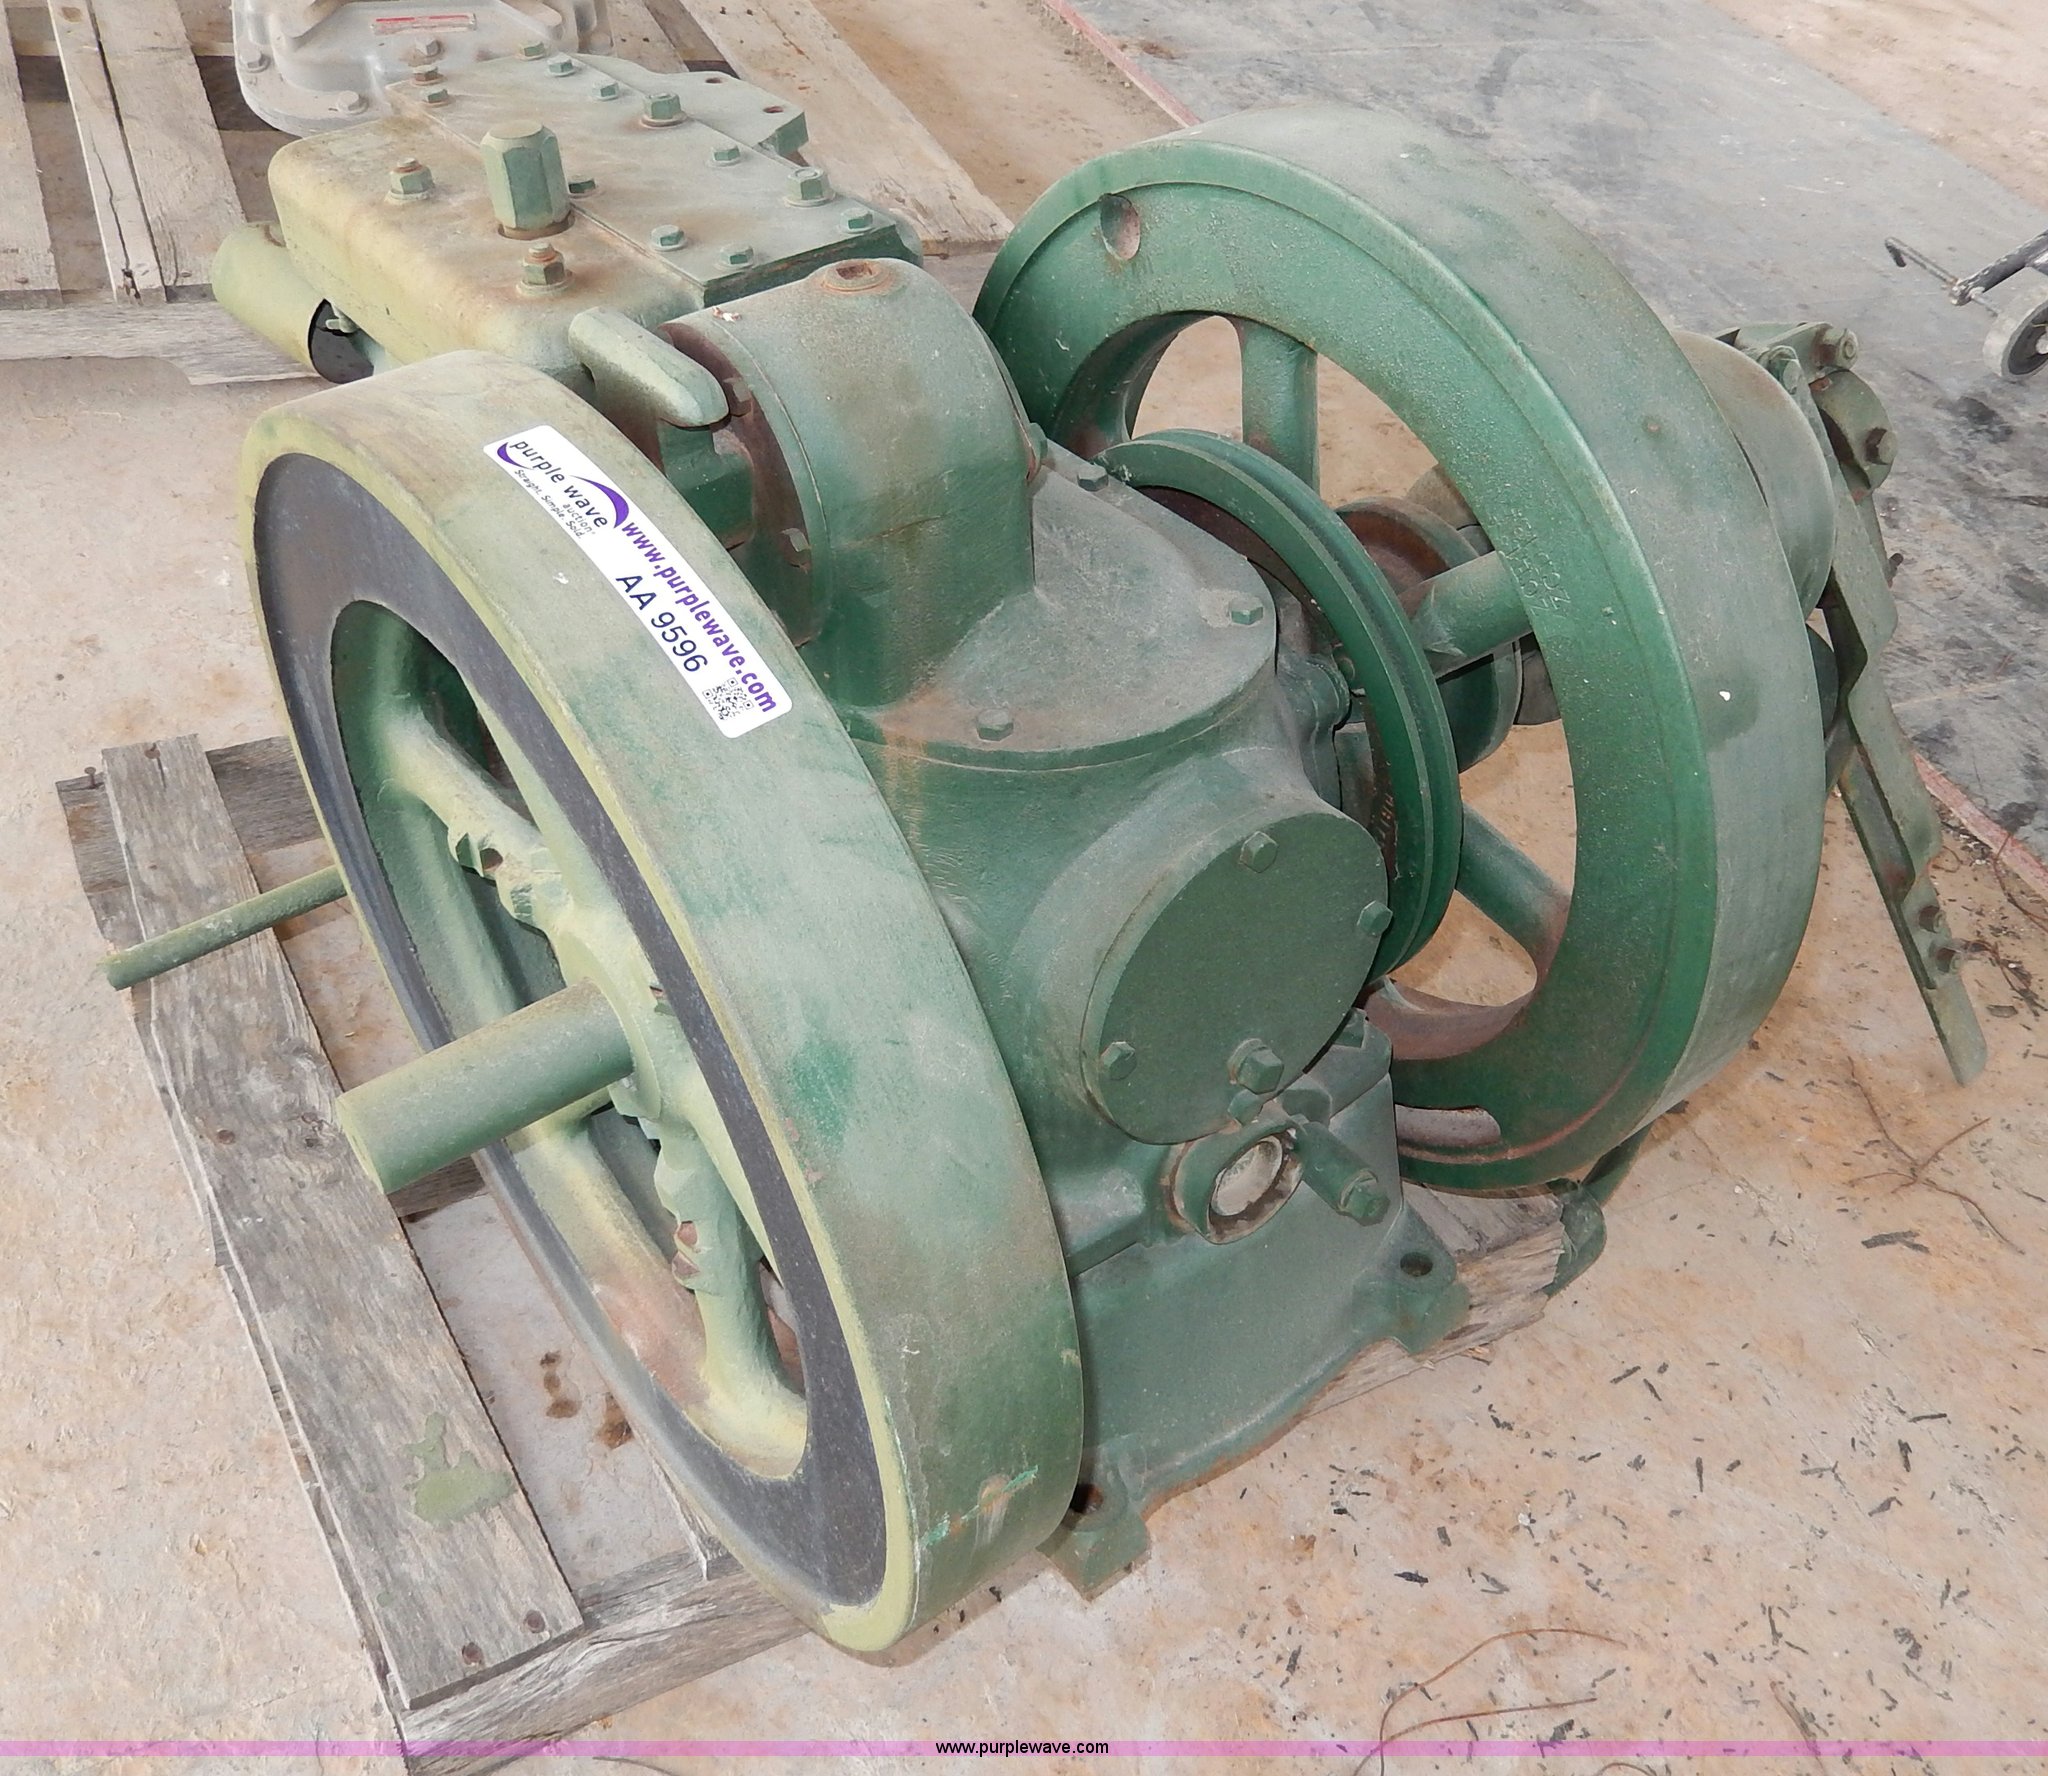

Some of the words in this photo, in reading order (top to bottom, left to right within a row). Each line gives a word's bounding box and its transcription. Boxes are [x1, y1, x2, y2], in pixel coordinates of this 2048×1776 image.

[509, 440, 565, 483] purple
[563, 485, 608, 528] wave
[514, 469, 542, 495] Straight.
[541, 495, 565, 520] Simple.
[565, 520, 585, 539] Sold.
[616, 575, 657, 611] AA
[650, 611, 708, 672] 9596
[621, 522, 777, 713] www.purplewave.com
